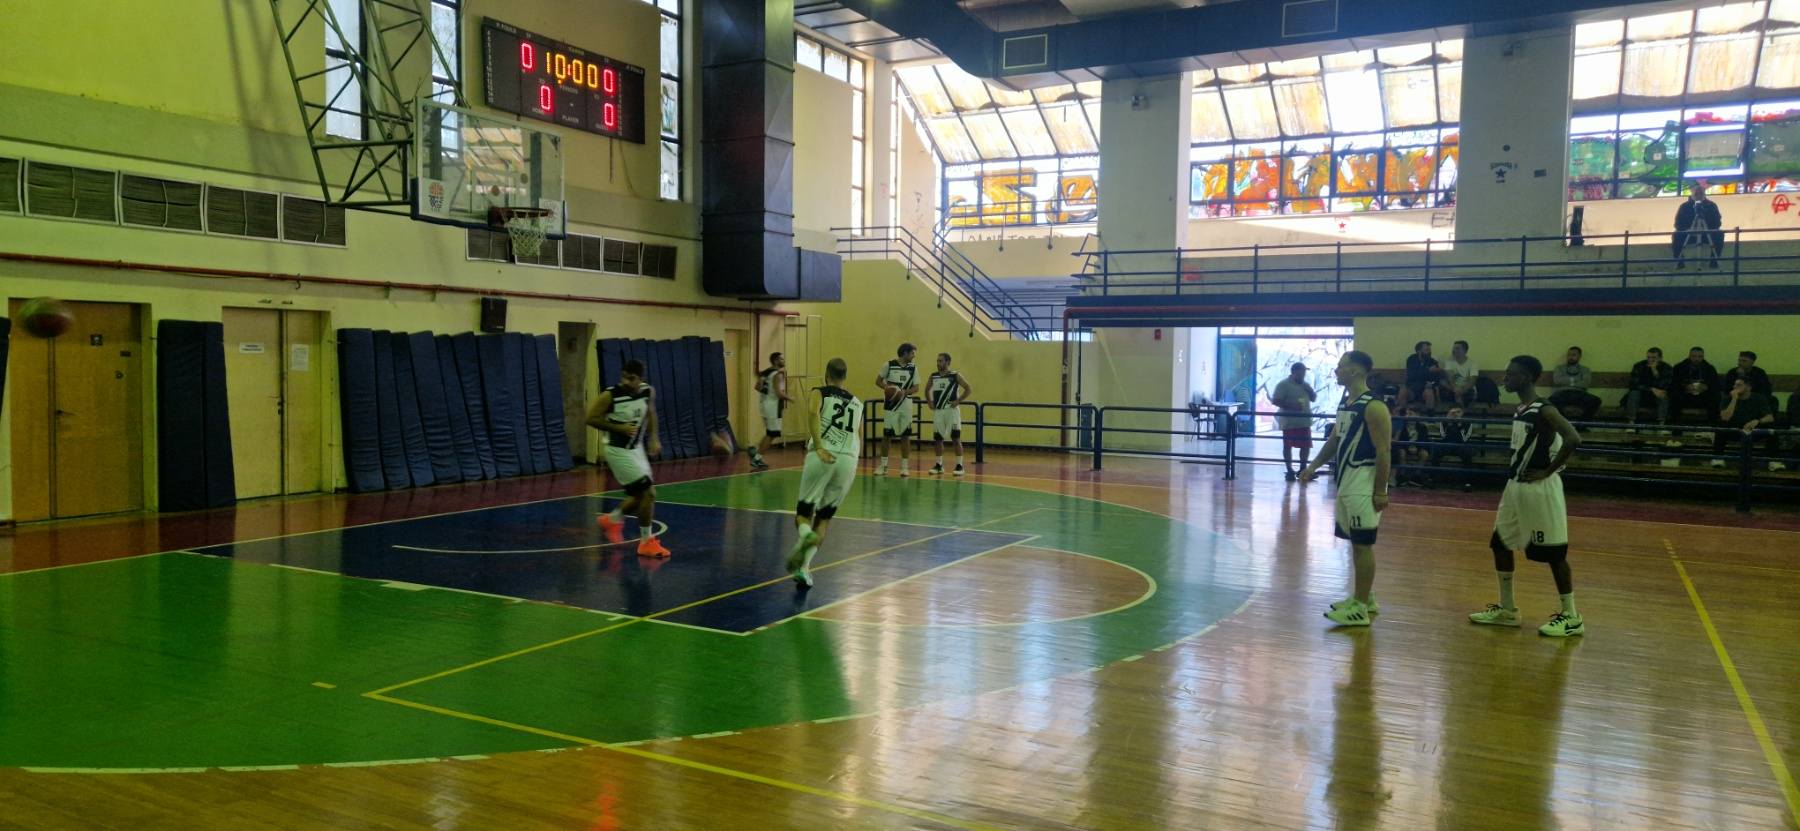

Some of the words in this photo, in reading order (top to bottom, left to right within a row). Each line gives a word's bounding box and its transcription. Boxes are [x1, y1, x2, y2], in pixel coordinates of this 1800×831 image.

[521, 42, 533, 69] 0
[603, 69, 614, 93] 0
[540, 85, 551, 110] 0
[604, 102, 614, 127] 0
[831, 403, 854, 433] 21
[1351, 515, 1362, 528] 11
[1532, 529, 1545, 543] 18
